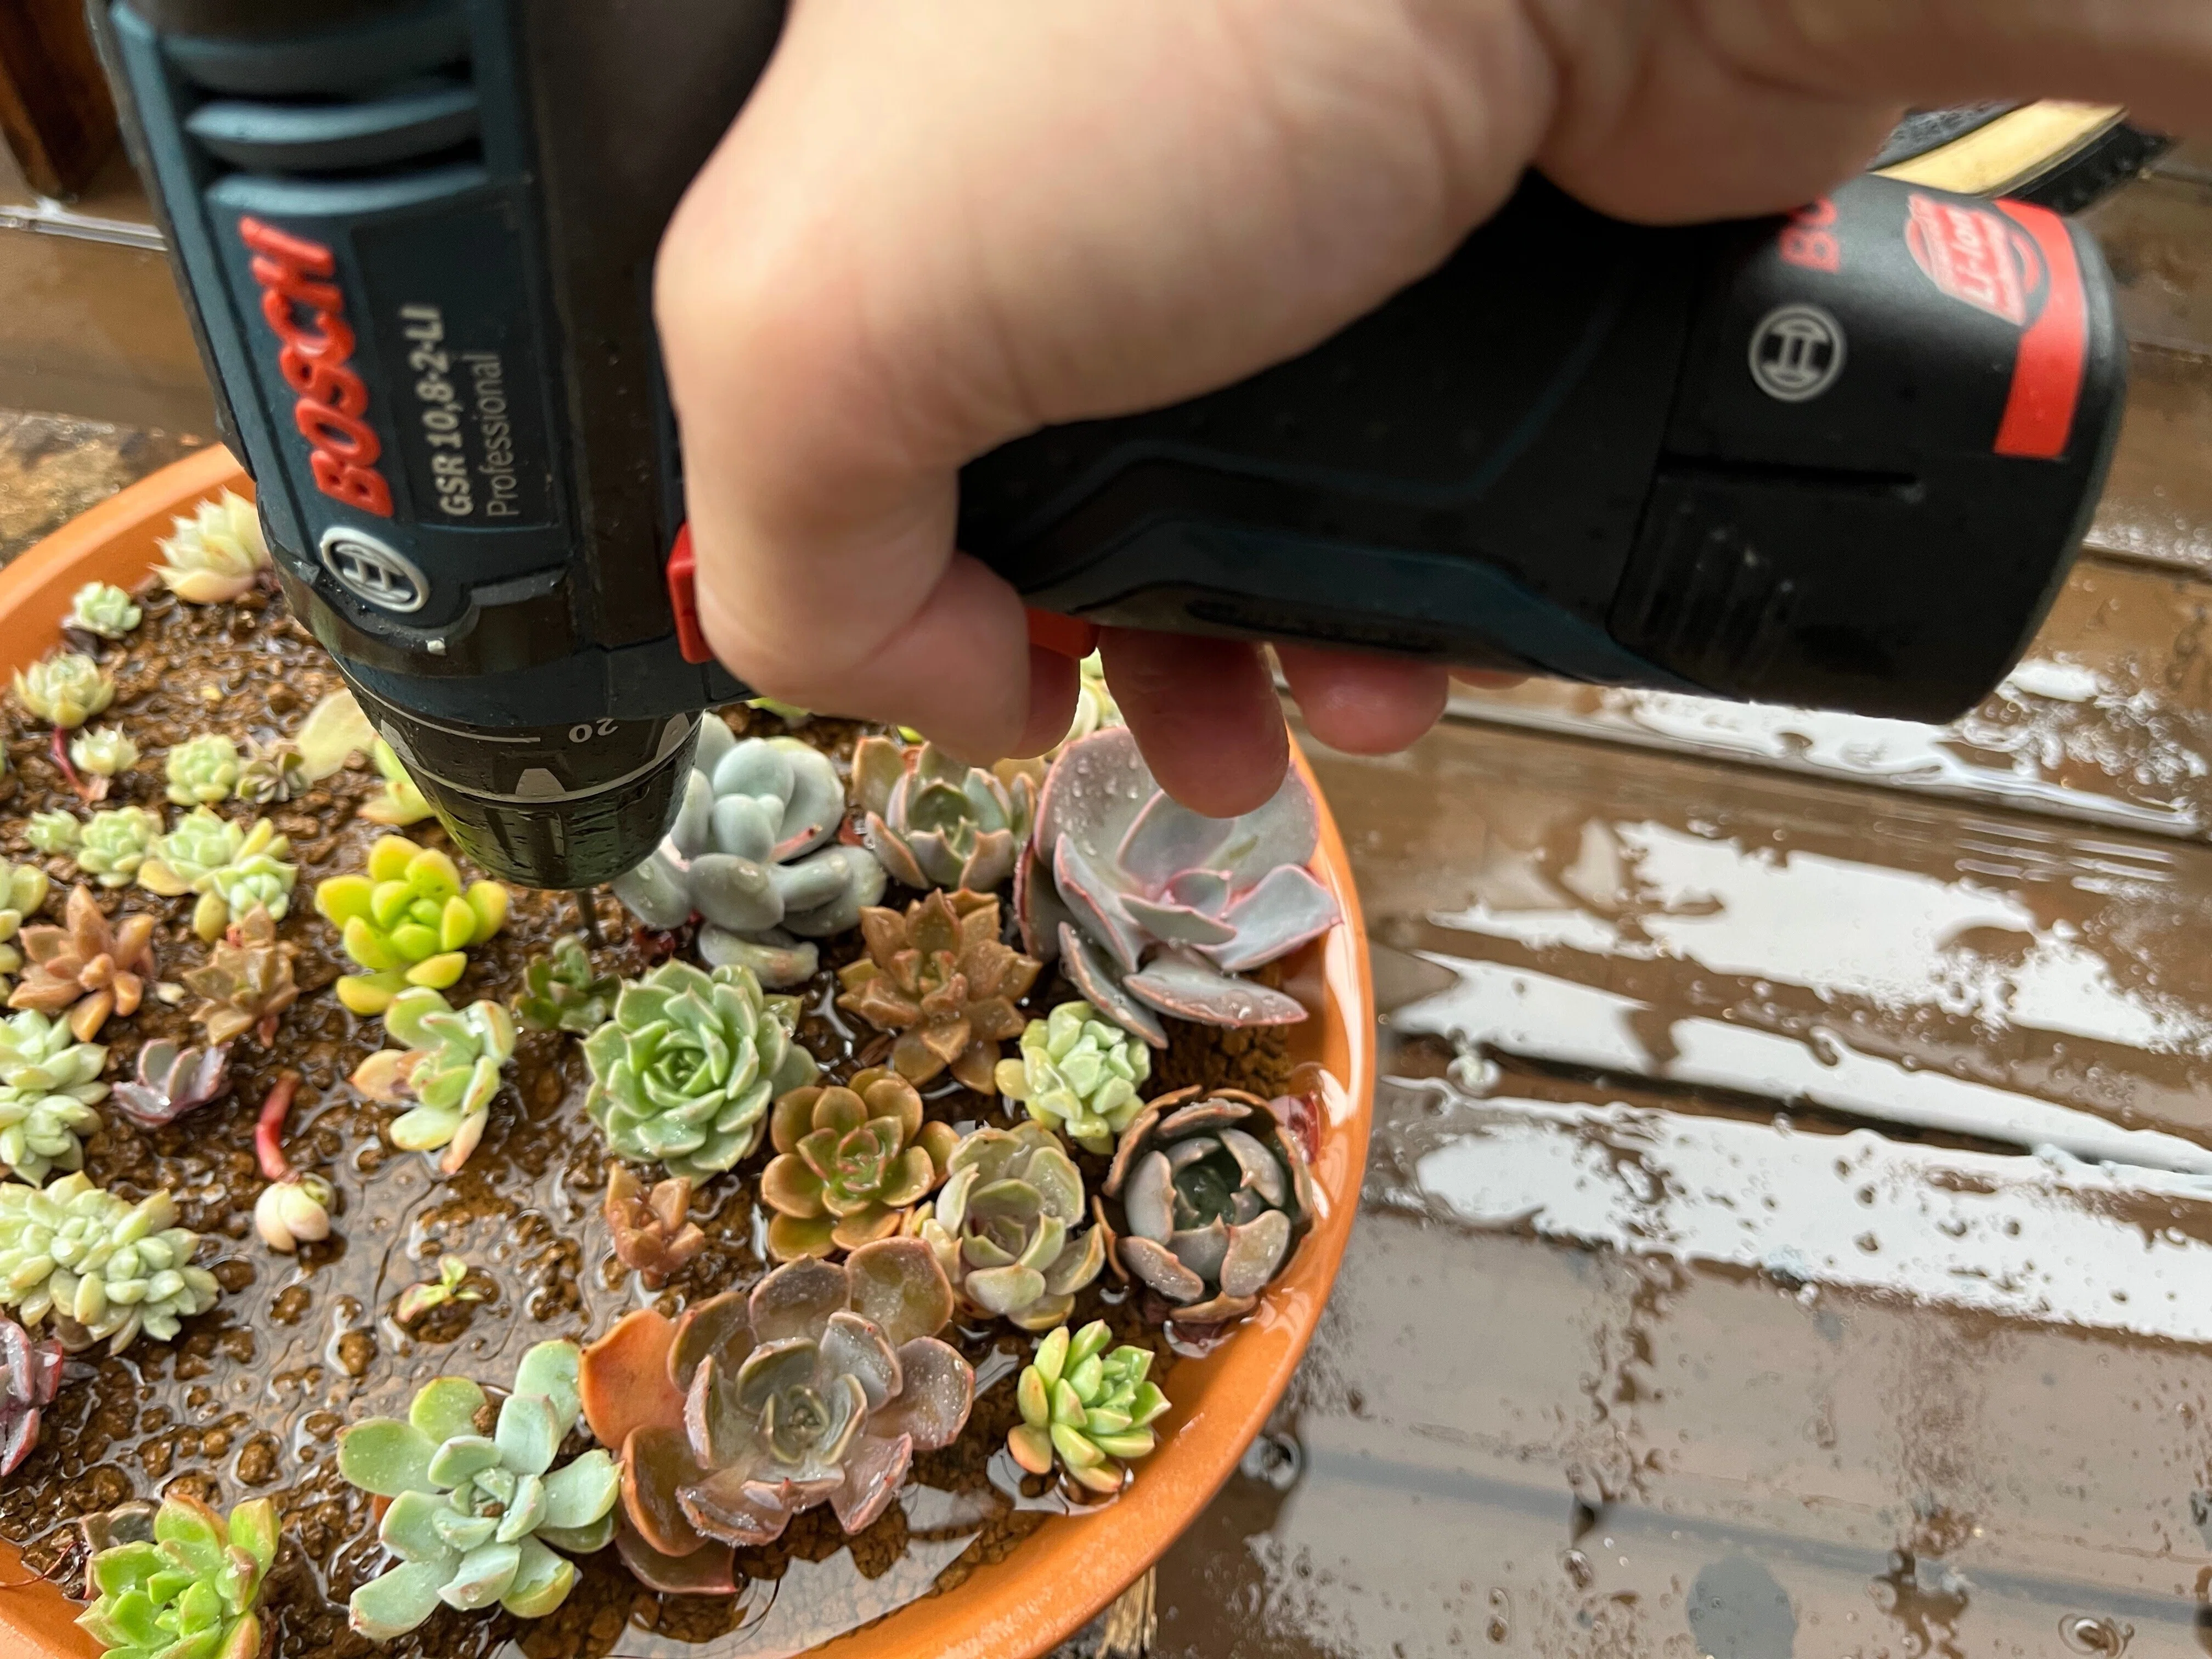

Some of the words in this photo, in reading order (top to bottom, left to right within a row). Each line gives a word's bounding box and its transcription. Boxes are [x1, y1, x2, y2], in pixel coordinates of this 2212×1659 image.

[238, 215, 393, 518] BOSCH
[432, 454, 473, 517] GSR
[462, 352, 519, 517] Professional
[568, 718, 618, 743] 20
